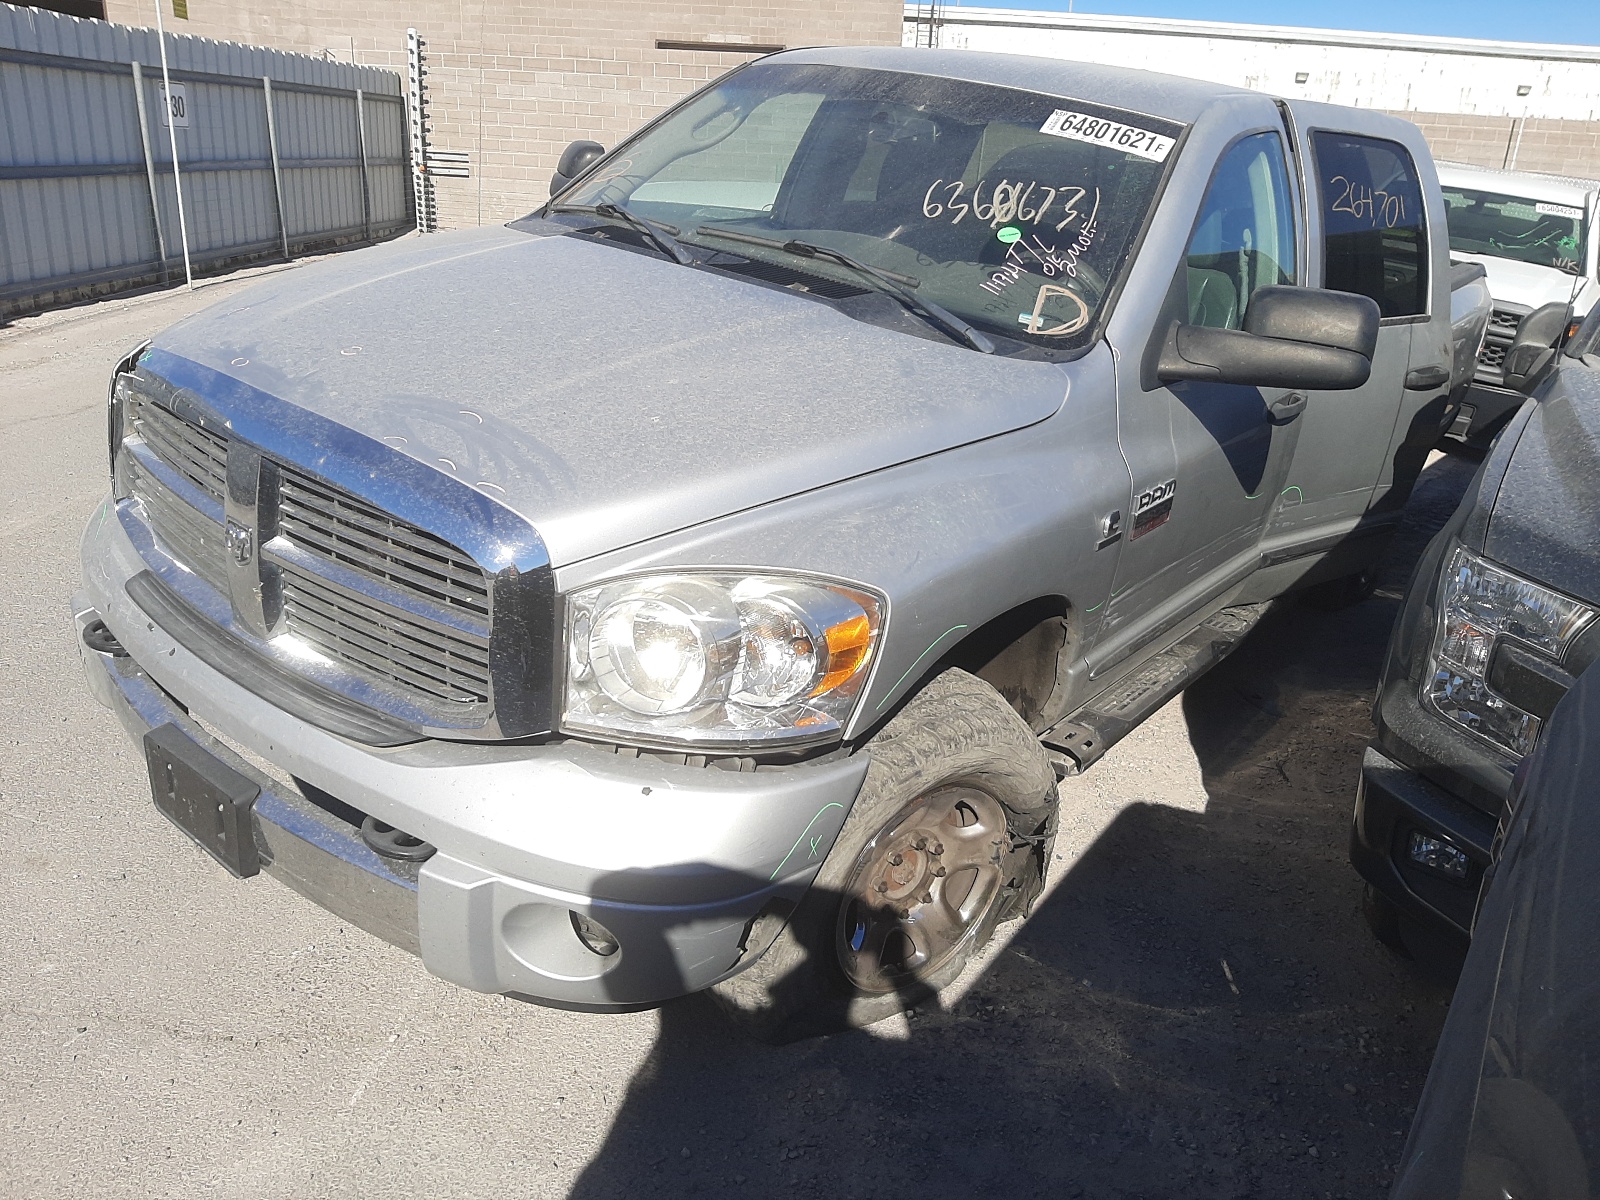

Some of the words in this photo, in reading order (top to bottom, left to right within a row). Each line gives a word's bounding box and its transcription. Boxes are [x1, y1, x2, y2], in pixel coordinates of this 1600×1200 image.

[1060, 114, 1158, 152] 64801621
[1154, 143, 1165, 153] F
[1136, 478, 1177, 512] RAM
